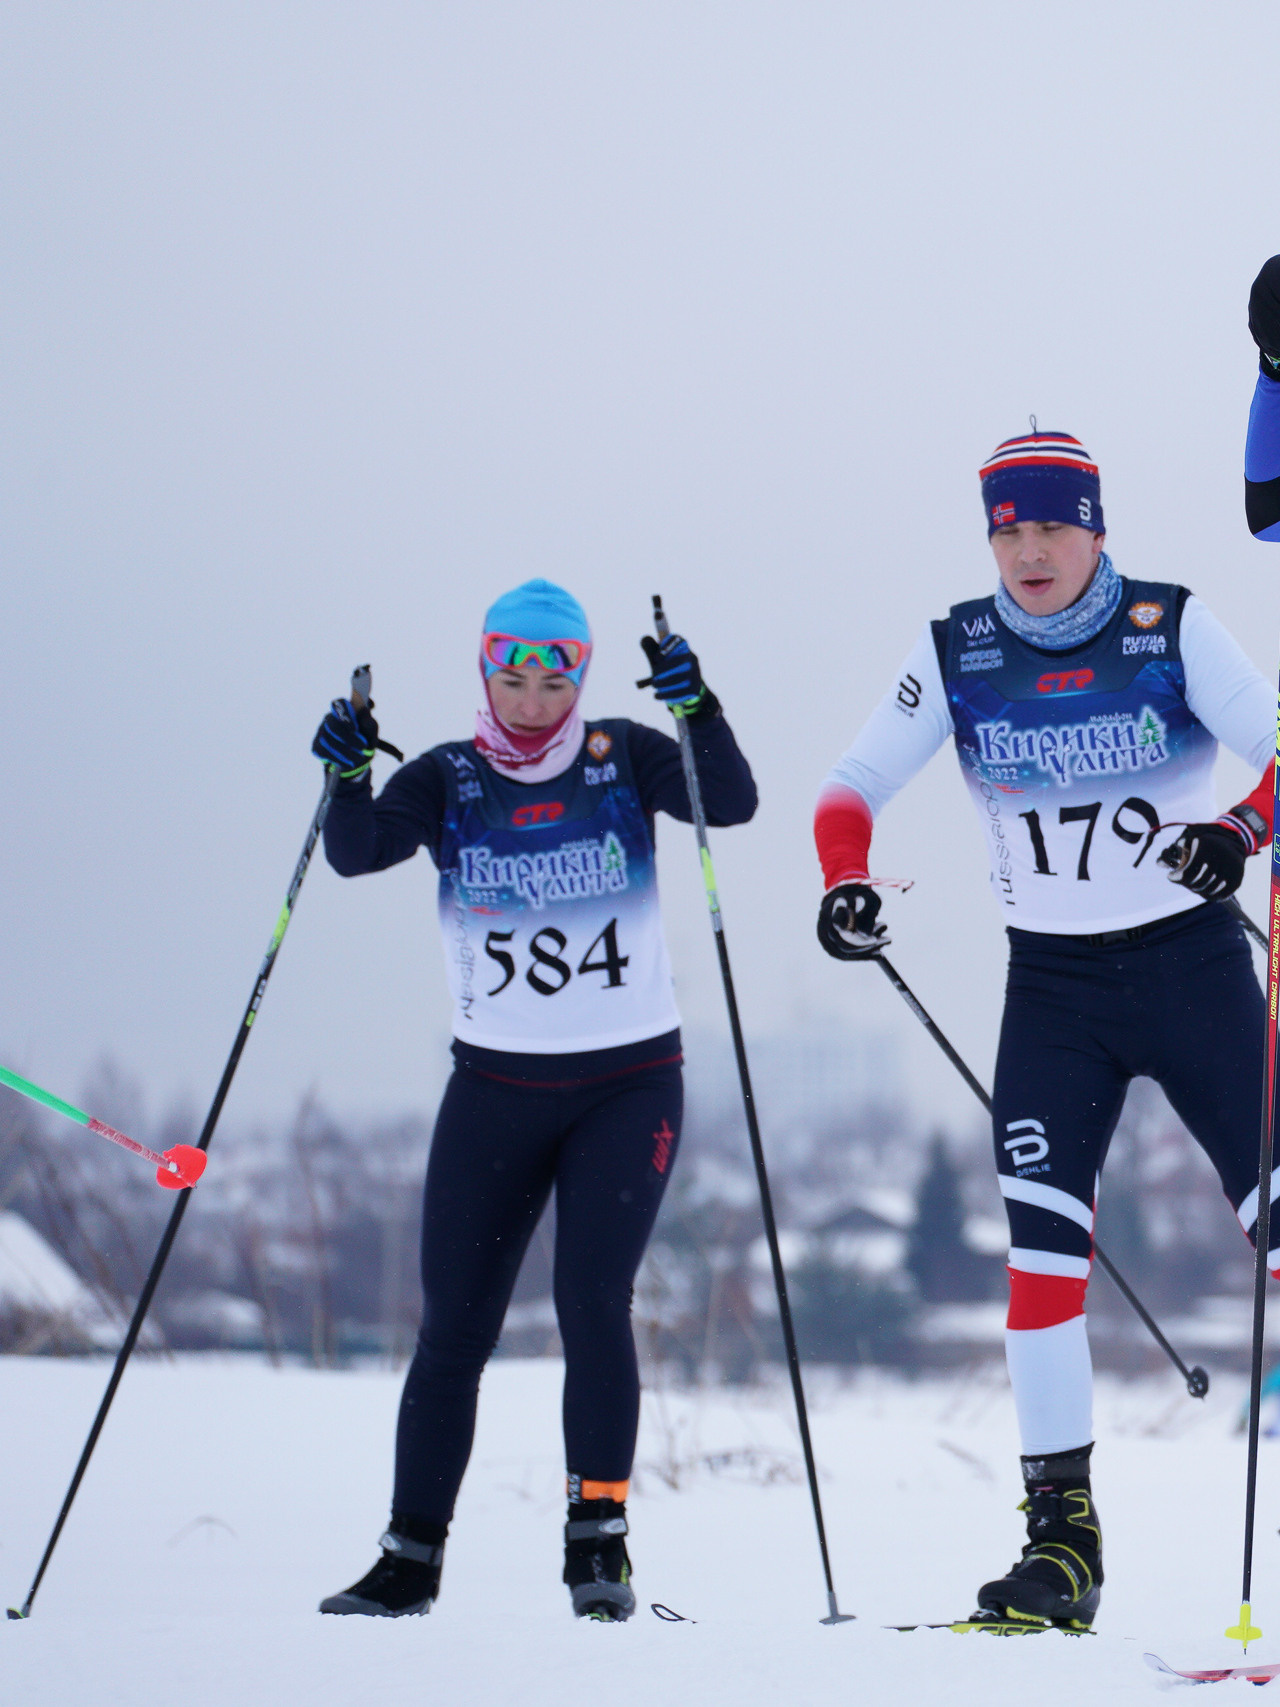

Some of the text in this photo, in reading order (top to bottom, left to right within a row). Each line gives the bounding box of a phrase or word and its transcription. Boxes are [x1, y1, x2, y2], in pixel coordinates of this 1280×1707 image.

[1018, 796, 1161, 881] 179
[484, 917, 630, 997] 584
[1269, 893, 1280, 1021] HIGH ULTRALIGHT CARBON
